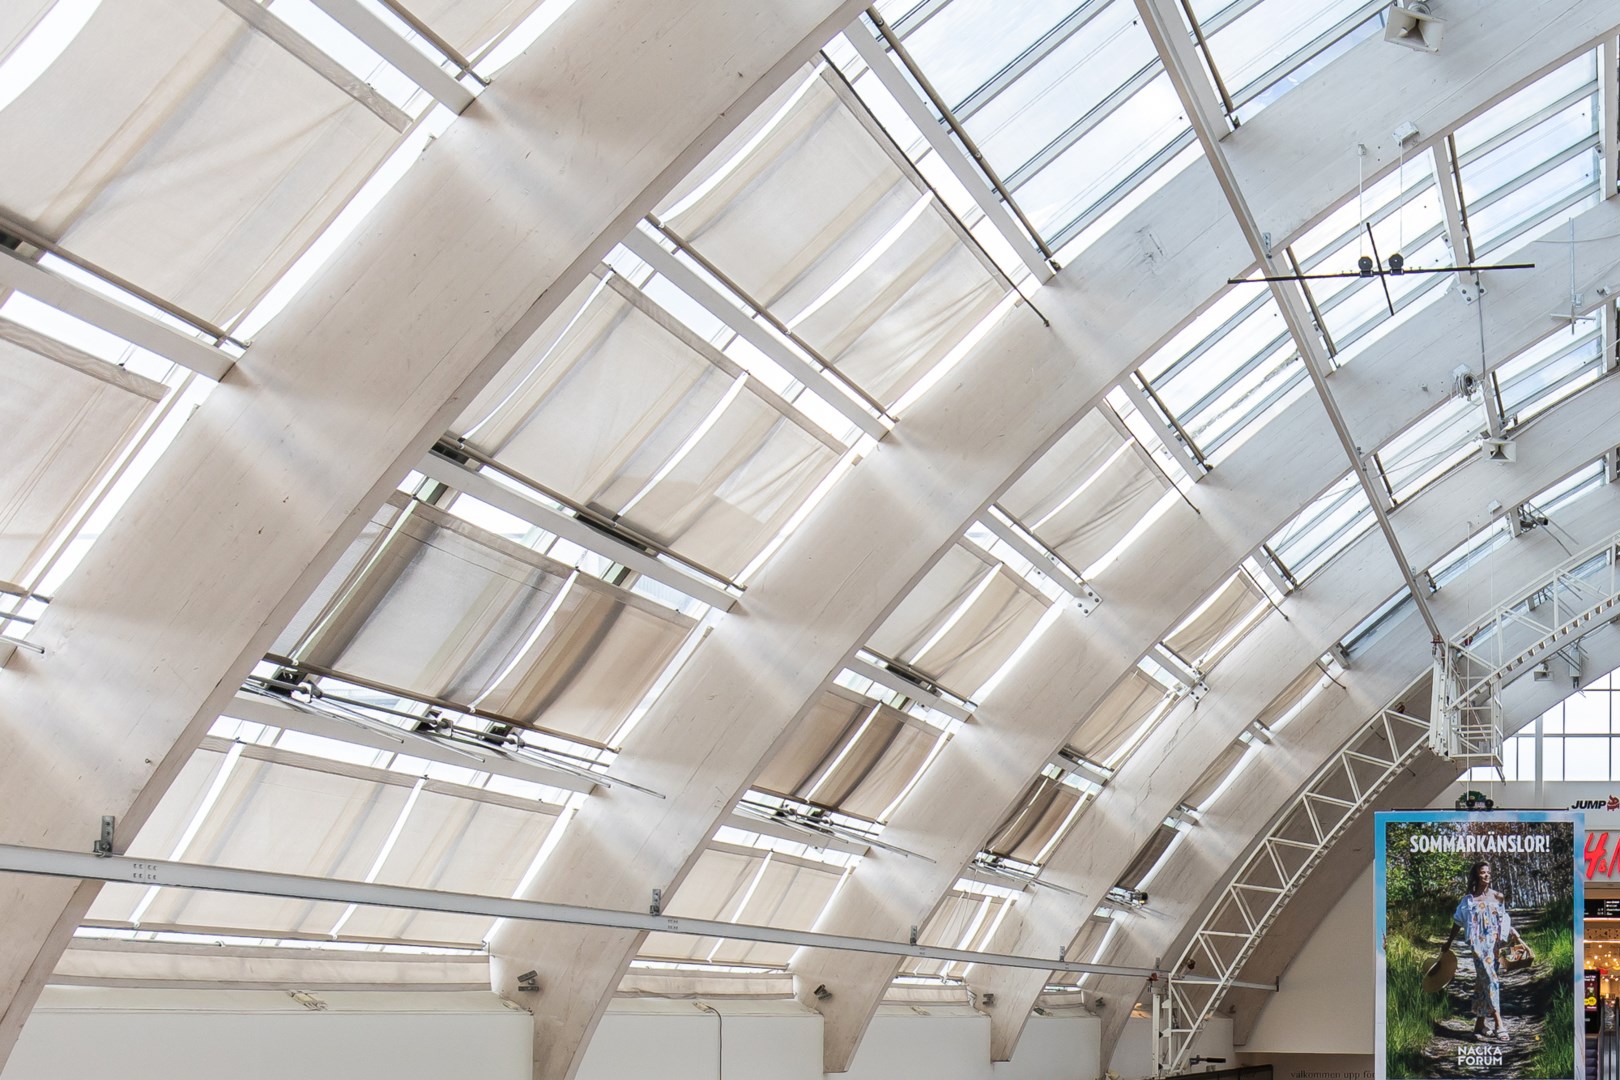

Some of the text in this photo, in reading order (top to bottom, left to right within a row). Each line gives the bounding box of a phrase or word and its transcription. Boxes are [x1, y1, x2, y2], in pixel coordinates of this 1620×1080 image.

[1571, 799, 1606, 810] JUMP
[1410, 832, 1550, 853] SOMMARKÄNSLOR!
[1458, 1046, 1502, 1056] NACKA
[1458, 1056, 1502, 1066] FORUM
[1343, 1072, 1360, 1080] upp
